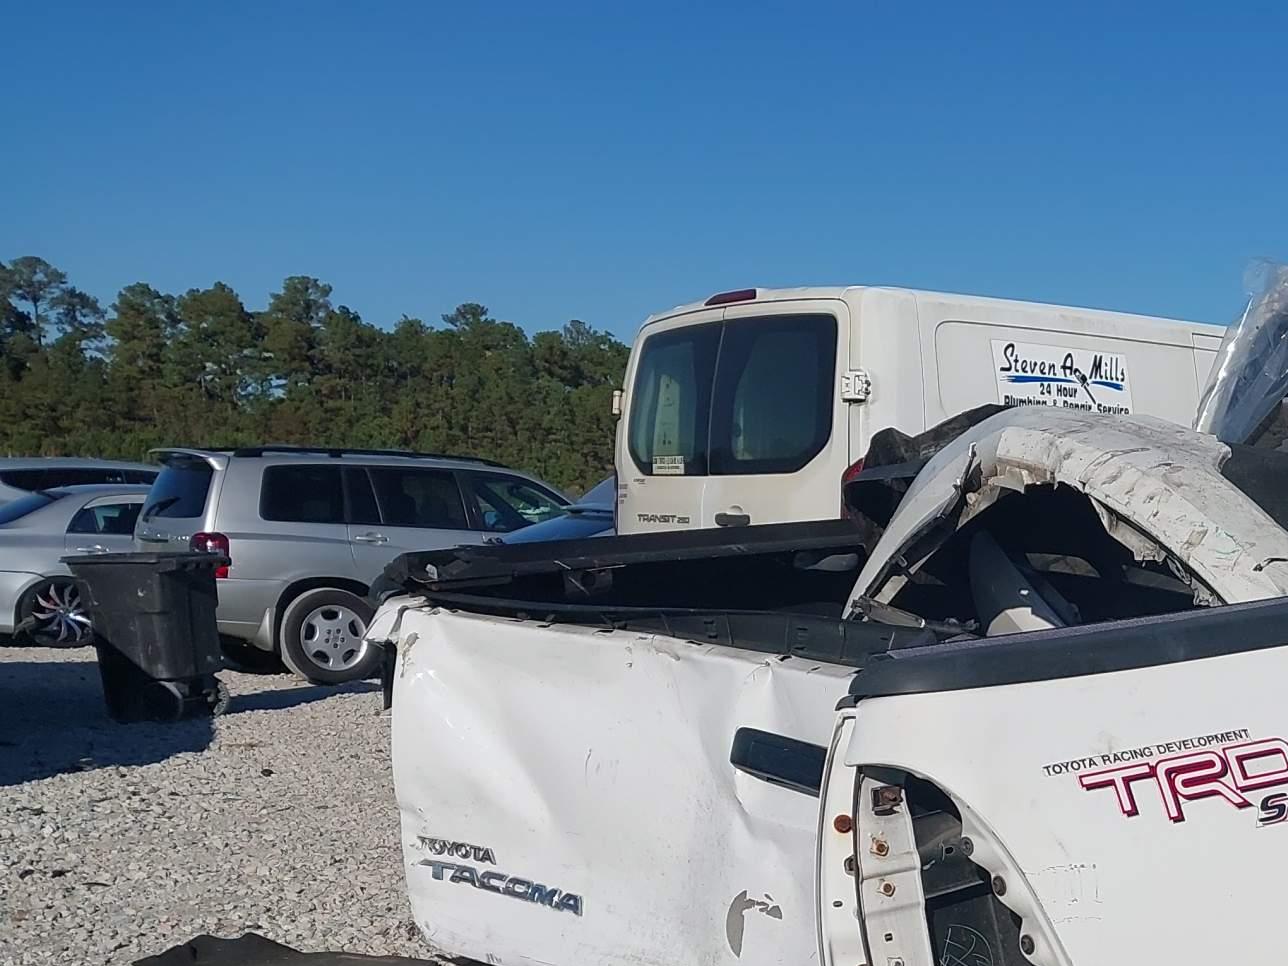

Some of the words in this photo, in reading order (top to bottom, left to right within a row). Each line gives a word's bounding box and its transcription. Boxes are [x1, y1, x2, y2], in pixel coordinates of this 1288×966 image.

[1000, 343, 1056, 377] Steven
[1088, 354, 1125, 382] Mills
[1040, 383, 1052, 395] 24
[1056, 384, 1078, 398] Hour
[637, 514, 677, 523] TRANSIT
[1043, 757, 1097, 777] TOYOTA
[1100, 746, 1154, 766] RACING
[1156, 728, 1251, 755] DEVELOPMENT
[417, 836, 497, 865] TOYOTA
[418, 859, 583, 917] TACOMA
